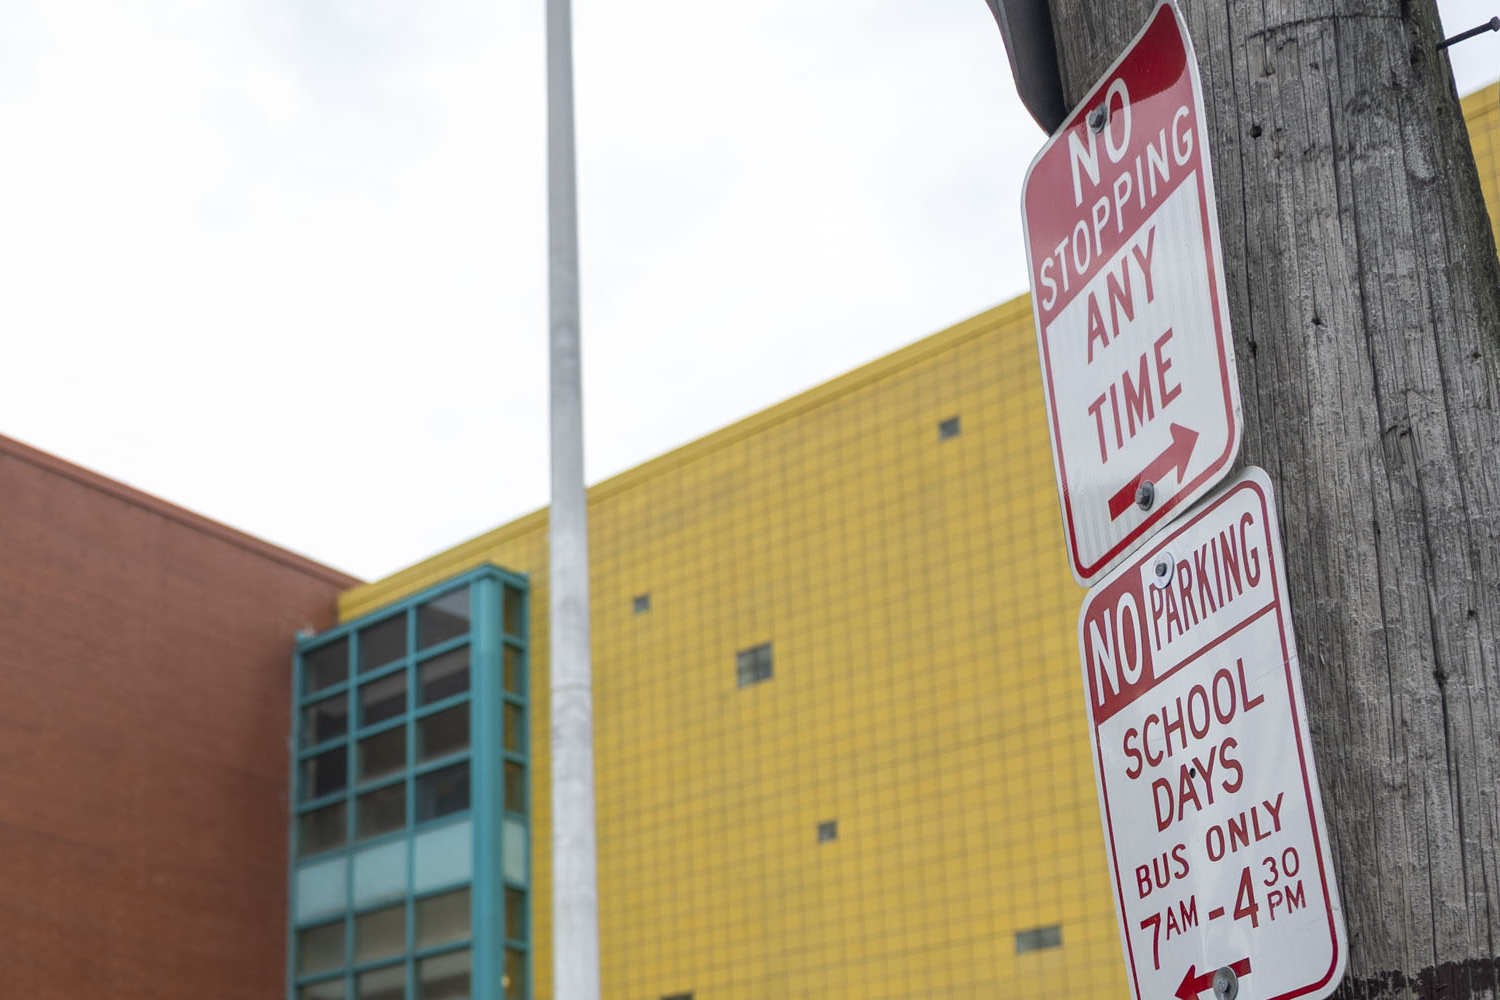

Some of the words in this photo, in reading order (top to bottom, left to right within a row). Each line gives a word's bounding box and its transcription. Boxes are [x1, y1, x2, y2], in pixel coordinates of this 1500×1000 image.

[1039, 105, 1194, 312] STOPPING
[1068, 77, 1132, 208] NO
[1087, 224, 1156, 366] ANY
[1087, 326, 1182, 465] TIME
[1089, 591, 1144, 708] NO
[1148, 511, 1261, 651] PARKING
[1122, 657, 1265, 780] SCHOOL
[1151, 737, 1244, 833] DAYS
[1135, 843, 1190, 899] BUS
[1205, 792, 1284, 862] ONLY
